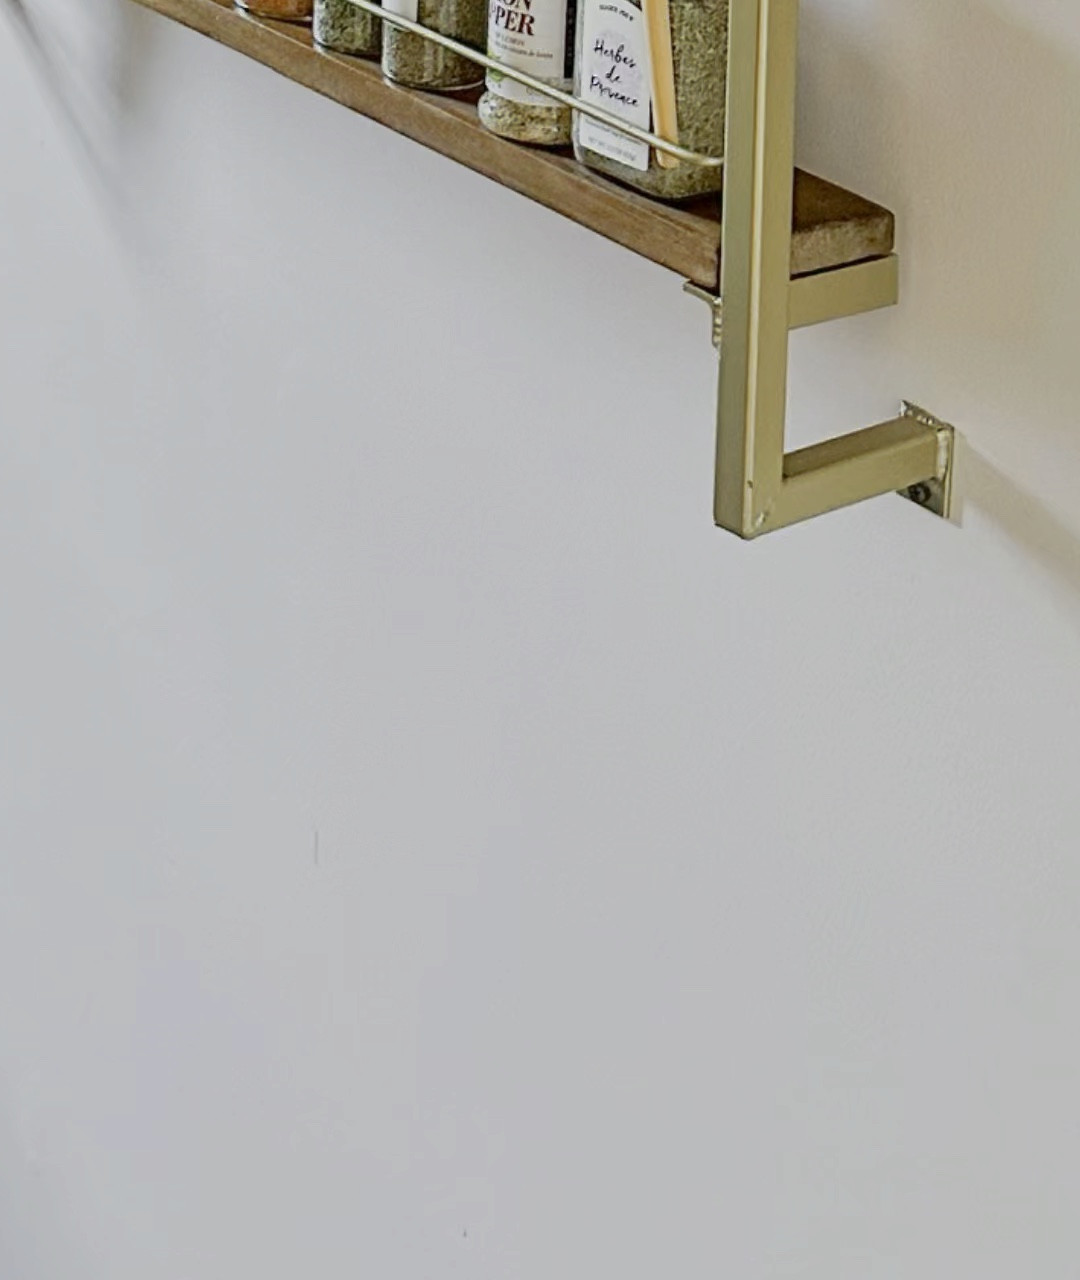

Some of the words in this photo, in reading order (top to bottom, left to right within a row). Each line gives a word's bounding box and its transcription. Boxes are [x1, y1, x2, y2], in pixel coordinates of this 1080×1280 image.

[593, 38, 637, 69] Herbes
[605, 65, 621, 83] de
[589, 74, 639, 108] Provence
